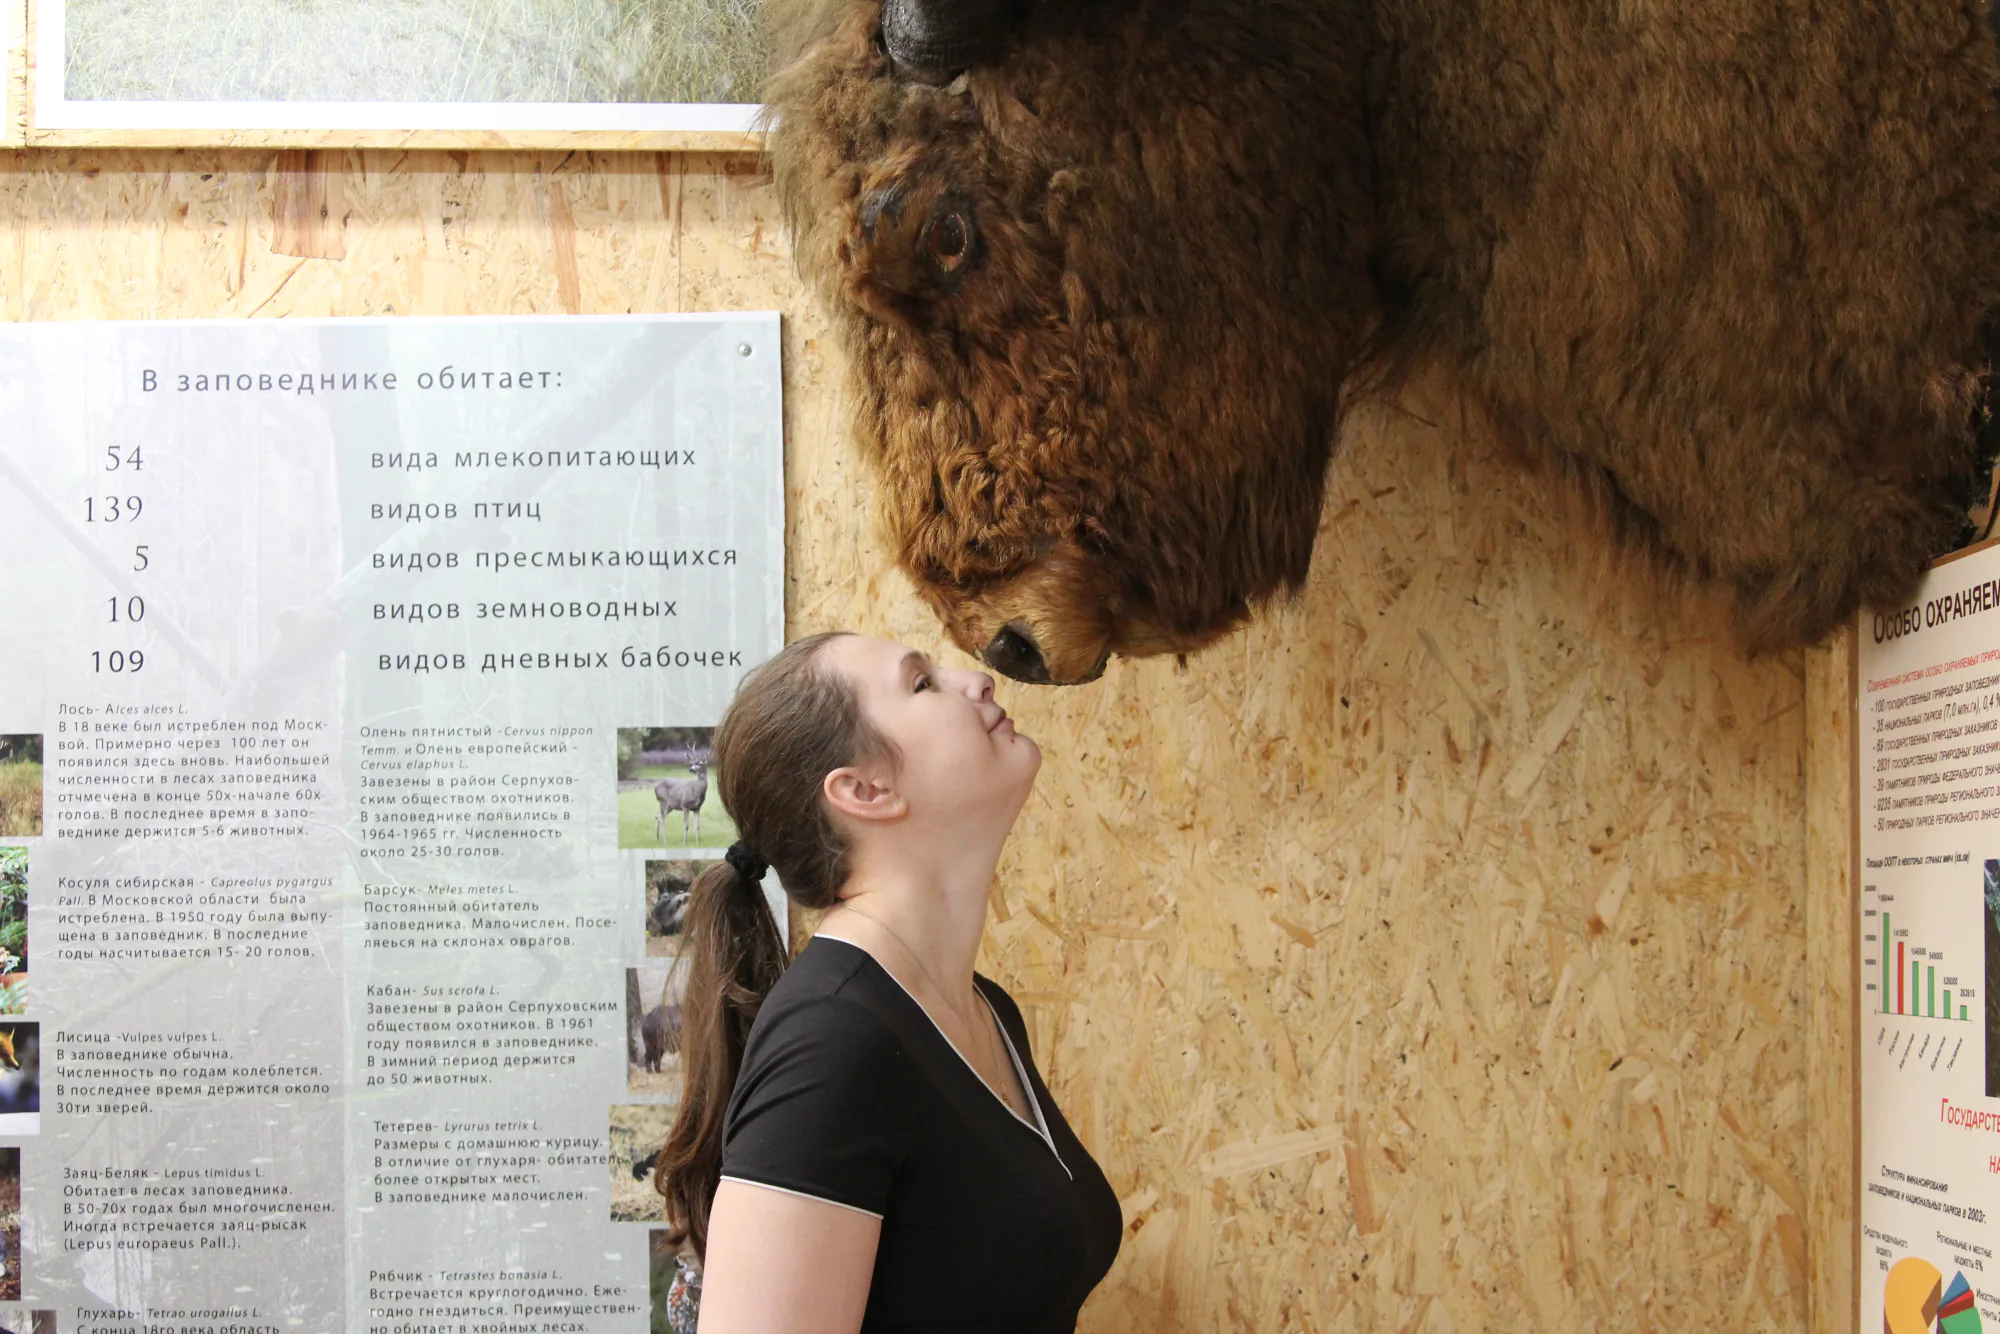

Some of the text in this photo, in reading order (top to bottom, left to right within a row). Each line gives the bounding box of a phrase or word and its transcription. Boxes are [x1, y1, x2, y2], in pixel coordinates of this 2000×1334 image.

[142, 368, 566, 395] В заповеднике обитает:
[105, 444, 695, 472] 54 вида млекопитающих
[84, 495, 541, 523] 139 видов птиц
[133, 544, 736, 573] 5 видов пресмыкающихся
[108, 595, 677, 624] 10 видов земноводных
[91, 644, 743, 674] 109 видов дневных бабочек
[177, 703, 188, 714] L.
[58, 720, 67, 733] В
[73, 720, 89, 733] 18
[94, 722, 128, 732] веке
[133, 719, 161, 732] был
[167, 718, 246, 734] истреблен
[251, 721, 279, 732] под
[58, 753, 329, 769] появился здесь вновь. Наибольшей
[58, 773, 317, 785] численности в лесах заповедника
[360, 775, 431, 788] Завезены
[436, 777, 444, 787] в
[449, 774, 496, 789] район
[359, 792, 574, 806] ским обществом охотников.
[57, 824, 308, 840] веднике держится 5-6 животных.
[360, 827, 562, 840] 1964-1965 гг. Численность
[359, 845, 504, 858] около 25-30 голов.
[88, 893, 97, 906] В
[102, 893, 193, 906] Московской
[199, 892, 259, 905] области
[269, 891, 306, 904] была
[363, 899, 539, 913] Постоянный обитатель
[364, 920, 466, 932] заповедника.
[471, 917, 569, 929] Малочислен.
[58, 949, 93, 961] годы
[99, 948, 211, 959] насчитывается
[245, 945, 262, 957] 20
[267, 947, 314, 957] голов.
[367, 1000, 618, 1016] Завезены в район Серпуховским
[55, 1030, 110, 1045] Лисица
[211, 1031, 222, 1042] L.
[56, 1063, 322, 1079] Численность по годам колеблется.
[366, 1072, 492, 1087] до 50 животных.
[56, 1083, 330, 1098] В последнее время держится около
[56, 1101, 153, 1116] 30ти зверей.
[373, 1137, 603, 1152] Размеры с домашнюю курицу.
[373, 1173, 540, 1188] более открытых мест.
[63, 1184, 293, 1197] Обитает в лесах заповедника.
[374, 1191, 588, 1204] В заповеднике малочислен.
[63, 1219, 307, 1234] Иногда встречается заяц-рысак
[369, 1287, 463, 1302] Встречается
[468, 1287, 588, 1301] круглогодично.
[252, 1307, 262, 1318] L.
[369, 1307, 414, 1319] годно
[418, 1306, 508, 1319] гнездиться.
